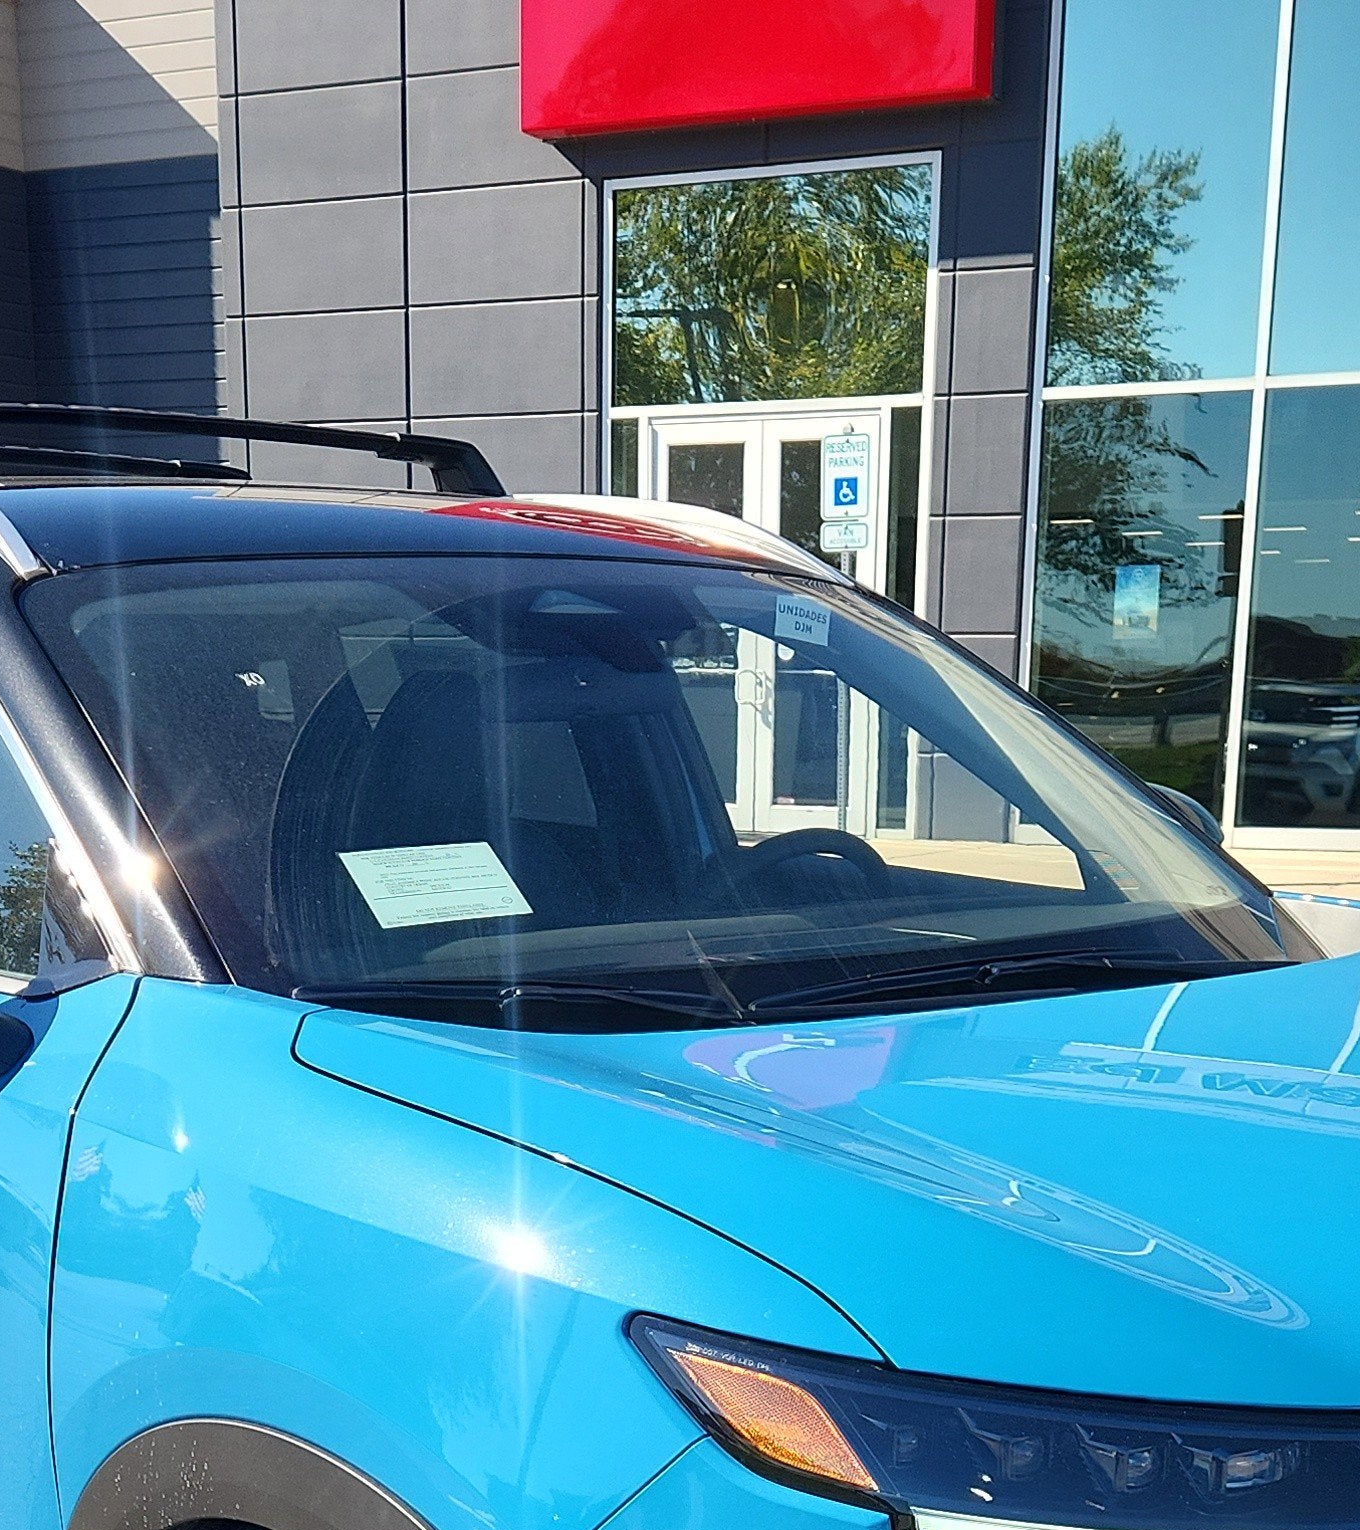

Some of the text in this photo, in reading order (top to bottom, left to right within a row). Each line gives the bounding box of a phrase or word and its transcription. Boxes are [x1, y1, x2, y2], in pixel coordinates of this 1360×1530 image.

[825, 440, 868, 454] RESERVED
[828, 455, 866, 468] PARKING
[837, 528, 854, 538] VAN
[778, 603, 828, 625] UNIDADES
[794, 619, 813, 635] DJM
